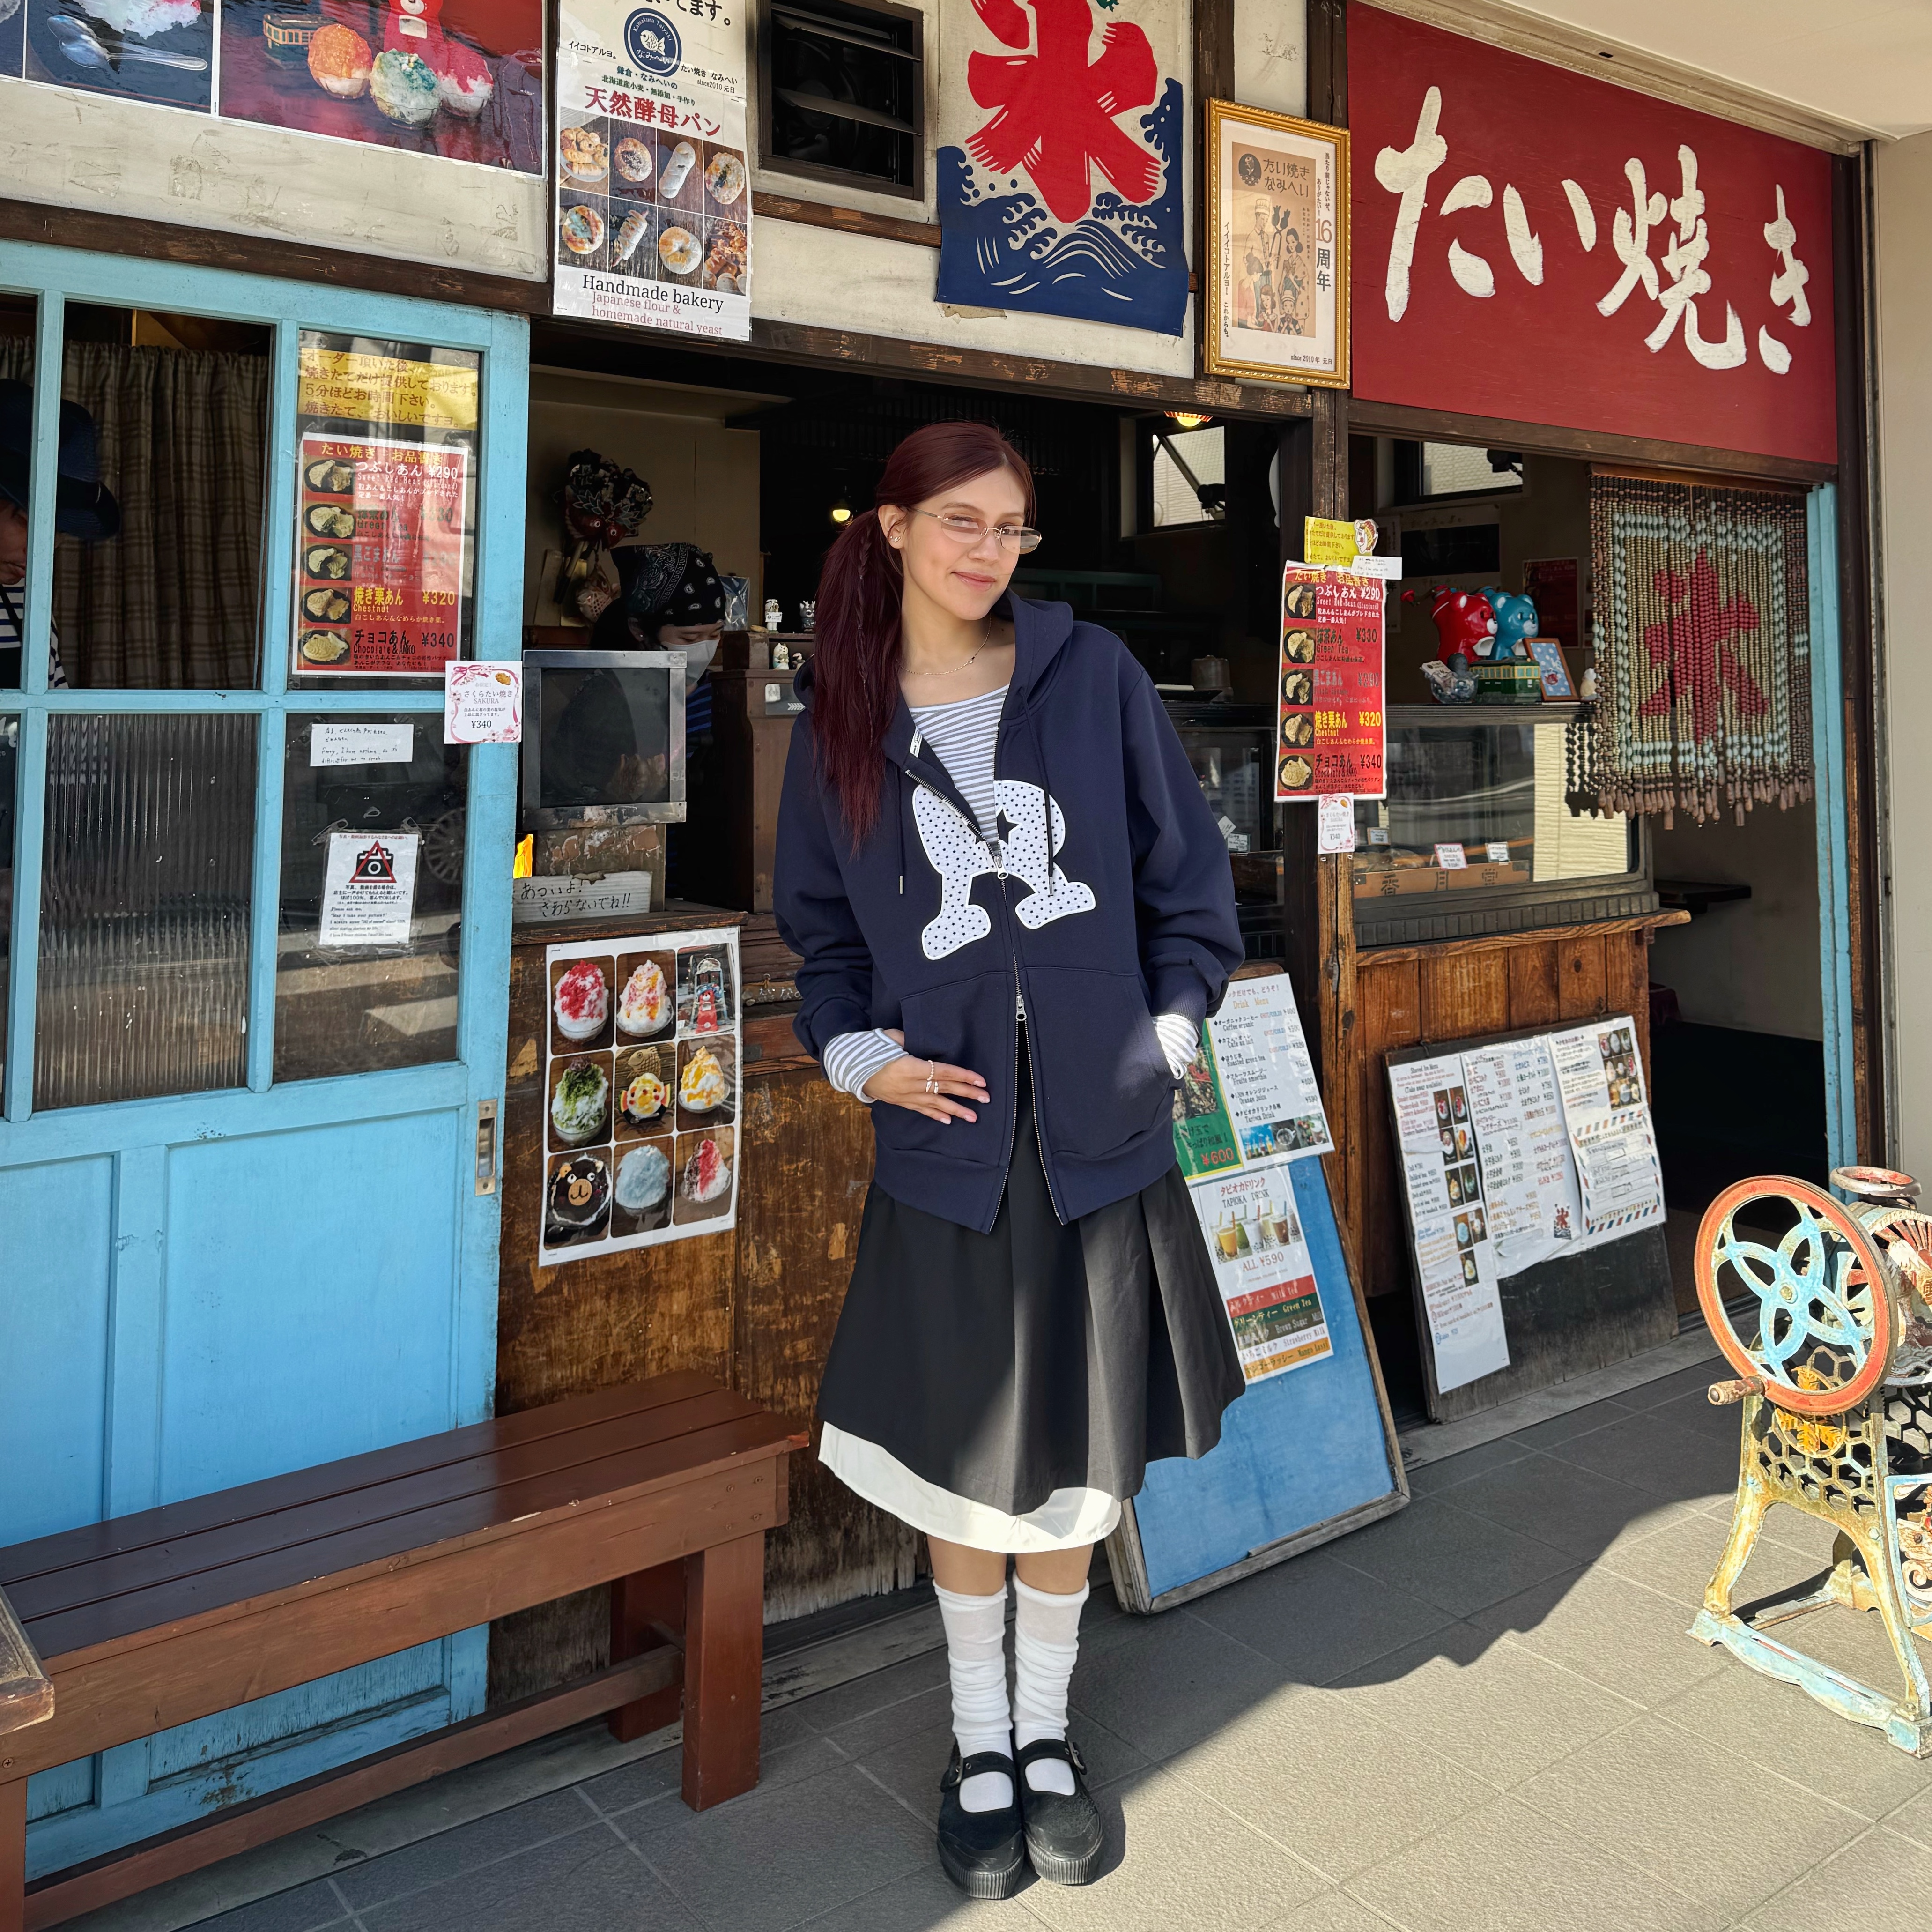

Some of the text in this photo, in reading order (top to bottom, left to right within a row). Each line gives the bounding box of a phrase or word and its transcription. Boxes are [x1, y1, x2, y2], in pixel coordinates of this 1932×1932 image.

[633, 16, 673, 41] Kamakura Taiyaki
[568, 40, 616, 59] イイコトアルヨ。
[636, 49, 670, 64] なみへい
[616, 65, 678, 89] 鎌倉・なみへいの
[681, 64, 738, 85] たい焼き なみへい
[601, 75, 695, 106] 北海道産小麦・無添加・手作り
[724, 85, 735, 94] 元日
[585, 85, 721, 136] 天然酵母パン
[1263, 159, 1310, 180] たい焼き
[1265, 177, 1309, 198] なみへい
[1374, 86, 1812, 374] たい焼き
[1315, 218, 1332, 292] 16周年
[583, 274, 724, 314] Handmade bakery
[592, 291, 681, 314] Japanese flour &
[592, 306, 723, 335] homemade natural yeast
[305, 350, 415, 374] オーダー頂いた後、
[1303, 355, 1314, 363] 2010
[304, 365, 476, 396] 焼きたてだけ提供しております。
[306, 383, 435, 409] 5分ほどお時間下さい。
[304, 401, 459, 428] 焼きたて、 おいしいですヨ。
[322, 443, 443, 465] たい焼き お品書き
[355, 461, 458, 479] つぶしあん ¥290
[358, 472, 379, 482] Sweet
[1295, 570, 1369, 586] たい焼き お品書き
[354, 586, 455, 606] 焼き栗あん ¥320
[1316, 586, 1380, 600] つぶしあん ¥290
[1317, 597, 1331, 606] Sweet
[353, 604, 389, 613] Chestnut
[355, 629, 454, 647] チョコあん ¥340
[1356, 628, 1377, 642] ¥330
[1317, 645, 1334, 653] Green
[1315, 711, 1381, 729] 焼き栗あん ¥320
[1316, 753, 1381, 769] チョコあん ¥340
[521, 880, 582, 900] あついよ！
[1233, 999, 1249, 1009] Drink
[1200, 1148, 1234, 1166] ¥600
[1221, 1176, 1266, 1196] タピオカドリンク
[1243, 1251, 1284, 1272] ALL ¥590
[1282, 1303, 1300, 1313] Green
[1301, 1298, 1311, 1307] Tea
